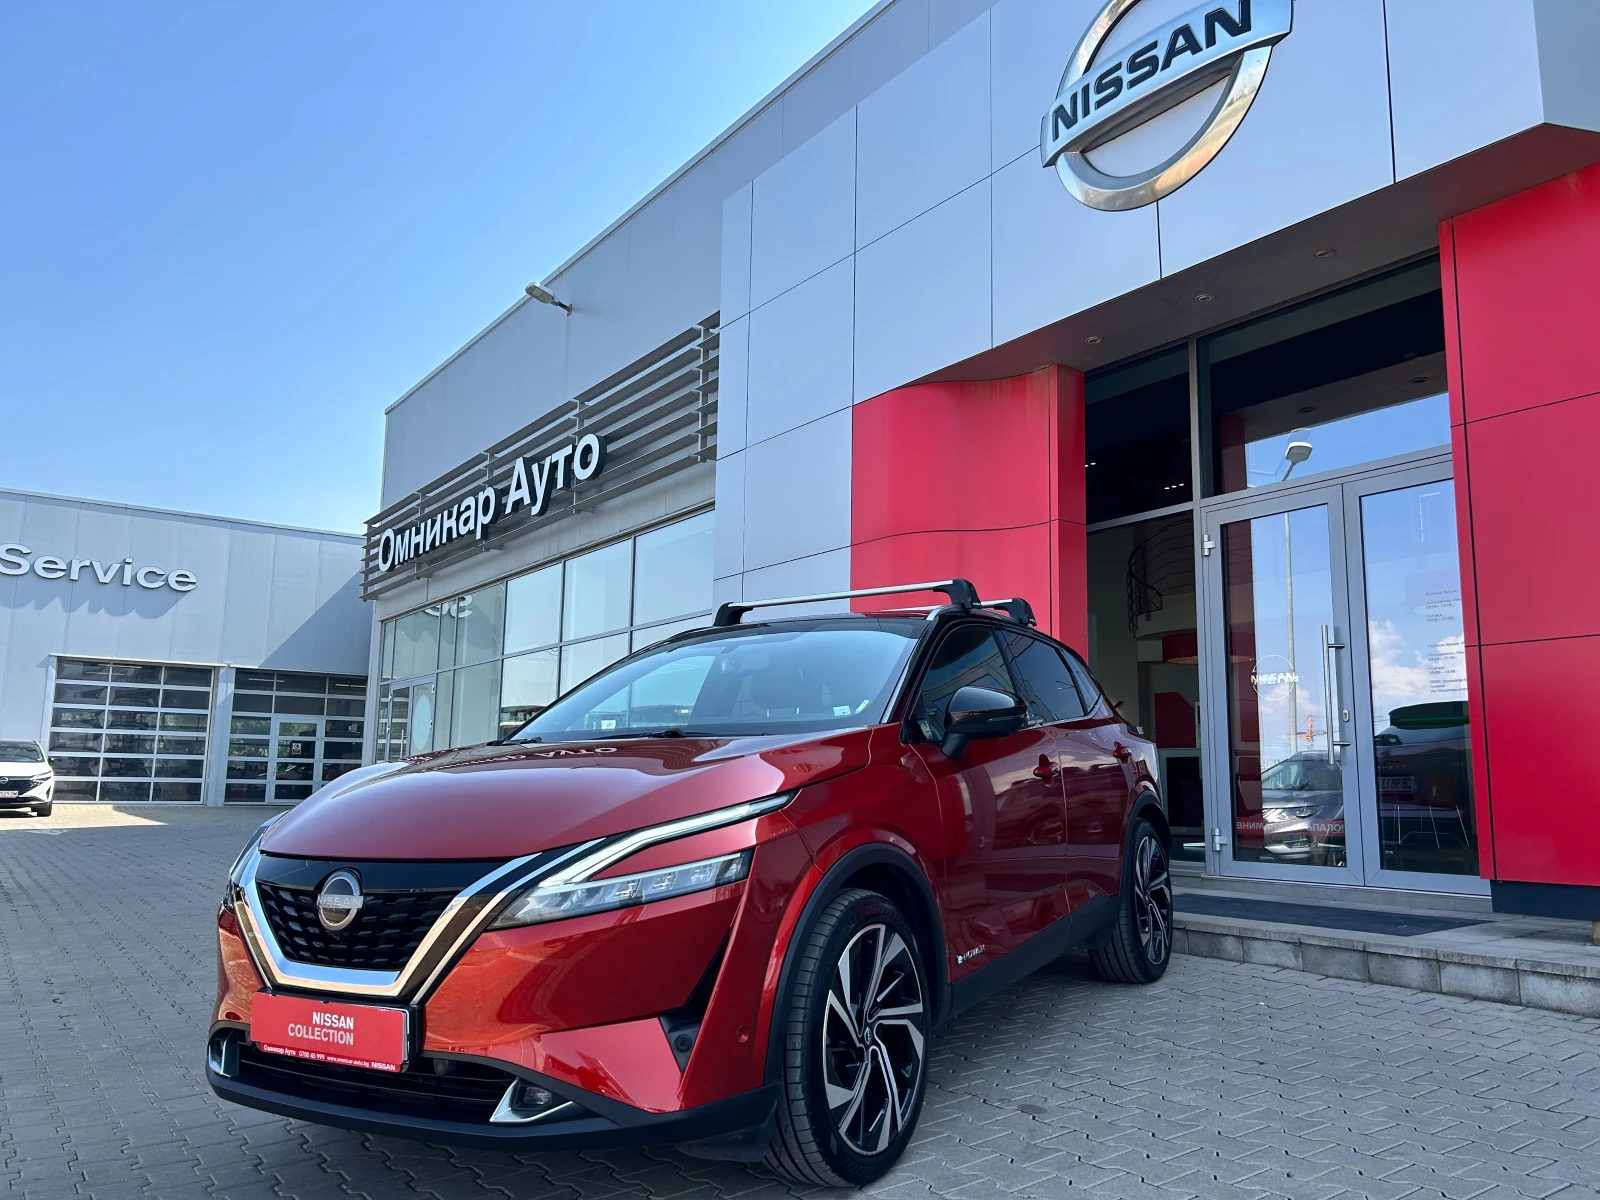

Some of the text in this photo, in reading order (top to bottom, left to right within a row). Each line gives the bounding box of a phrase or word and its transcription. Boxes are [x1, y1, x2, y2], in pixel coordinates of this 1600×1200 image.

[1052, 0, 1251, 142] NISSAN
[378, 433, 602, 572] Омникар Ауто
[0, 543, 197, 591] Service
[317, 896, 362, 906] NISSAN
[312, 1011, 354, 1030] NISSAN
[288, 1023, 354, 1045] COLLECTION
[371, 1061, 396, 1071] NISSAN
